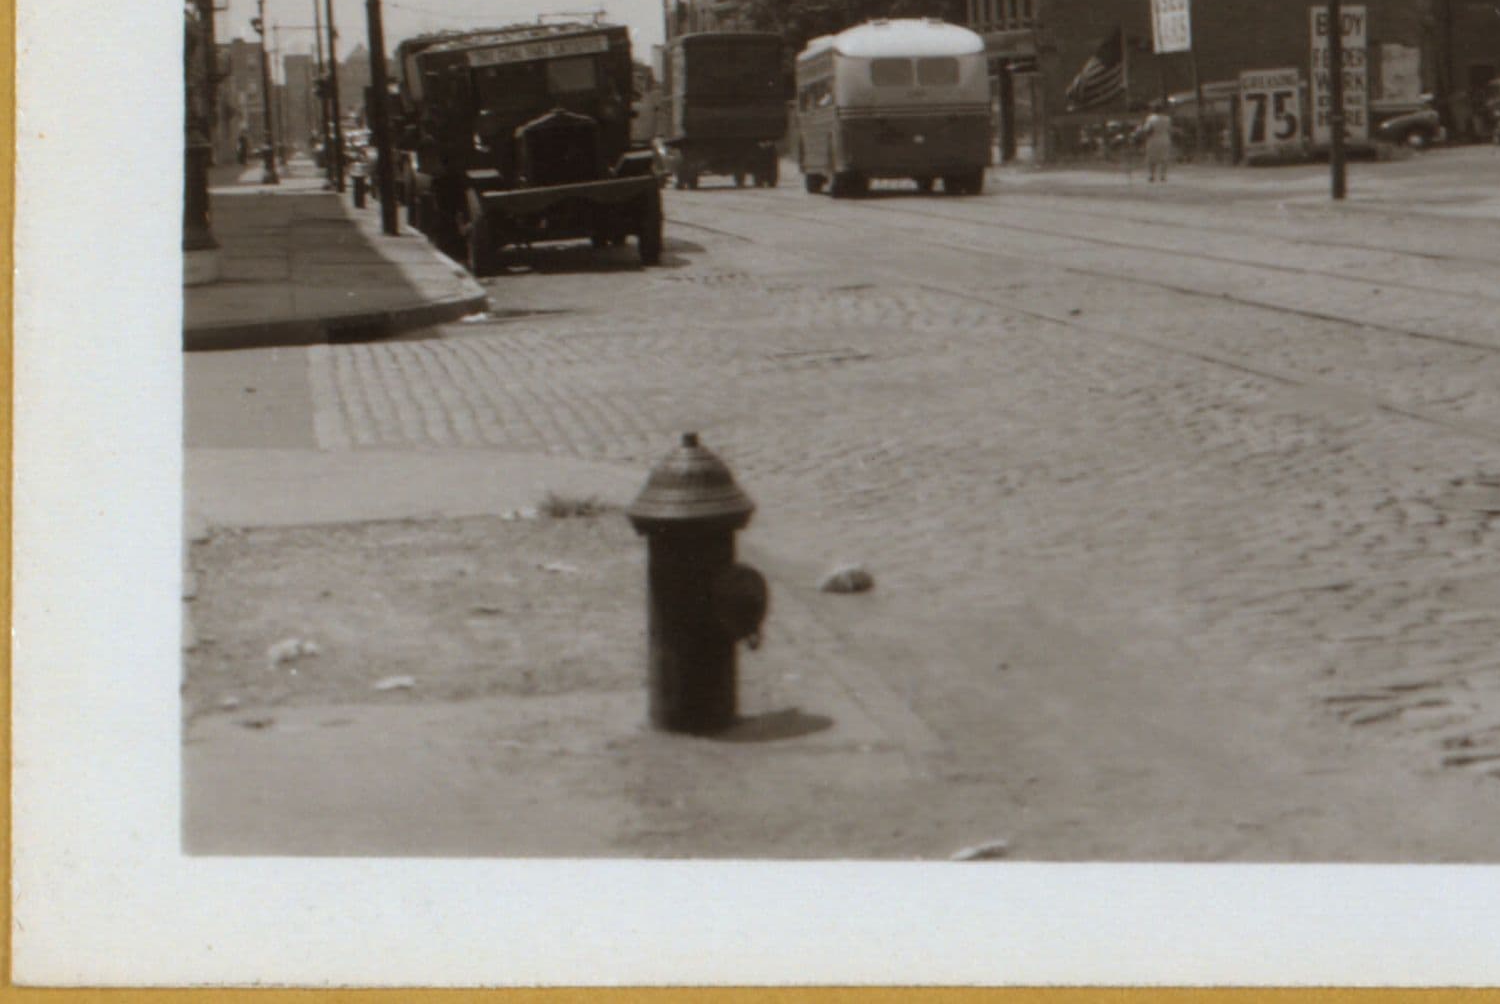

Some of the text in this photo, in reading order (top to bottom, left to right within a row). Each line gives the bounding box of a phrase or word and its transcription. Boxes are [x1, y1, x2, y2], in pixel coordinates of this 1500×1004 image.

[1315, 13, 1363, 36] BDY
[1315, 71, 1365, 92] WRK
[1245, 91, 1297, 144] 75
[1318, 110, 1363, 128] HRE
